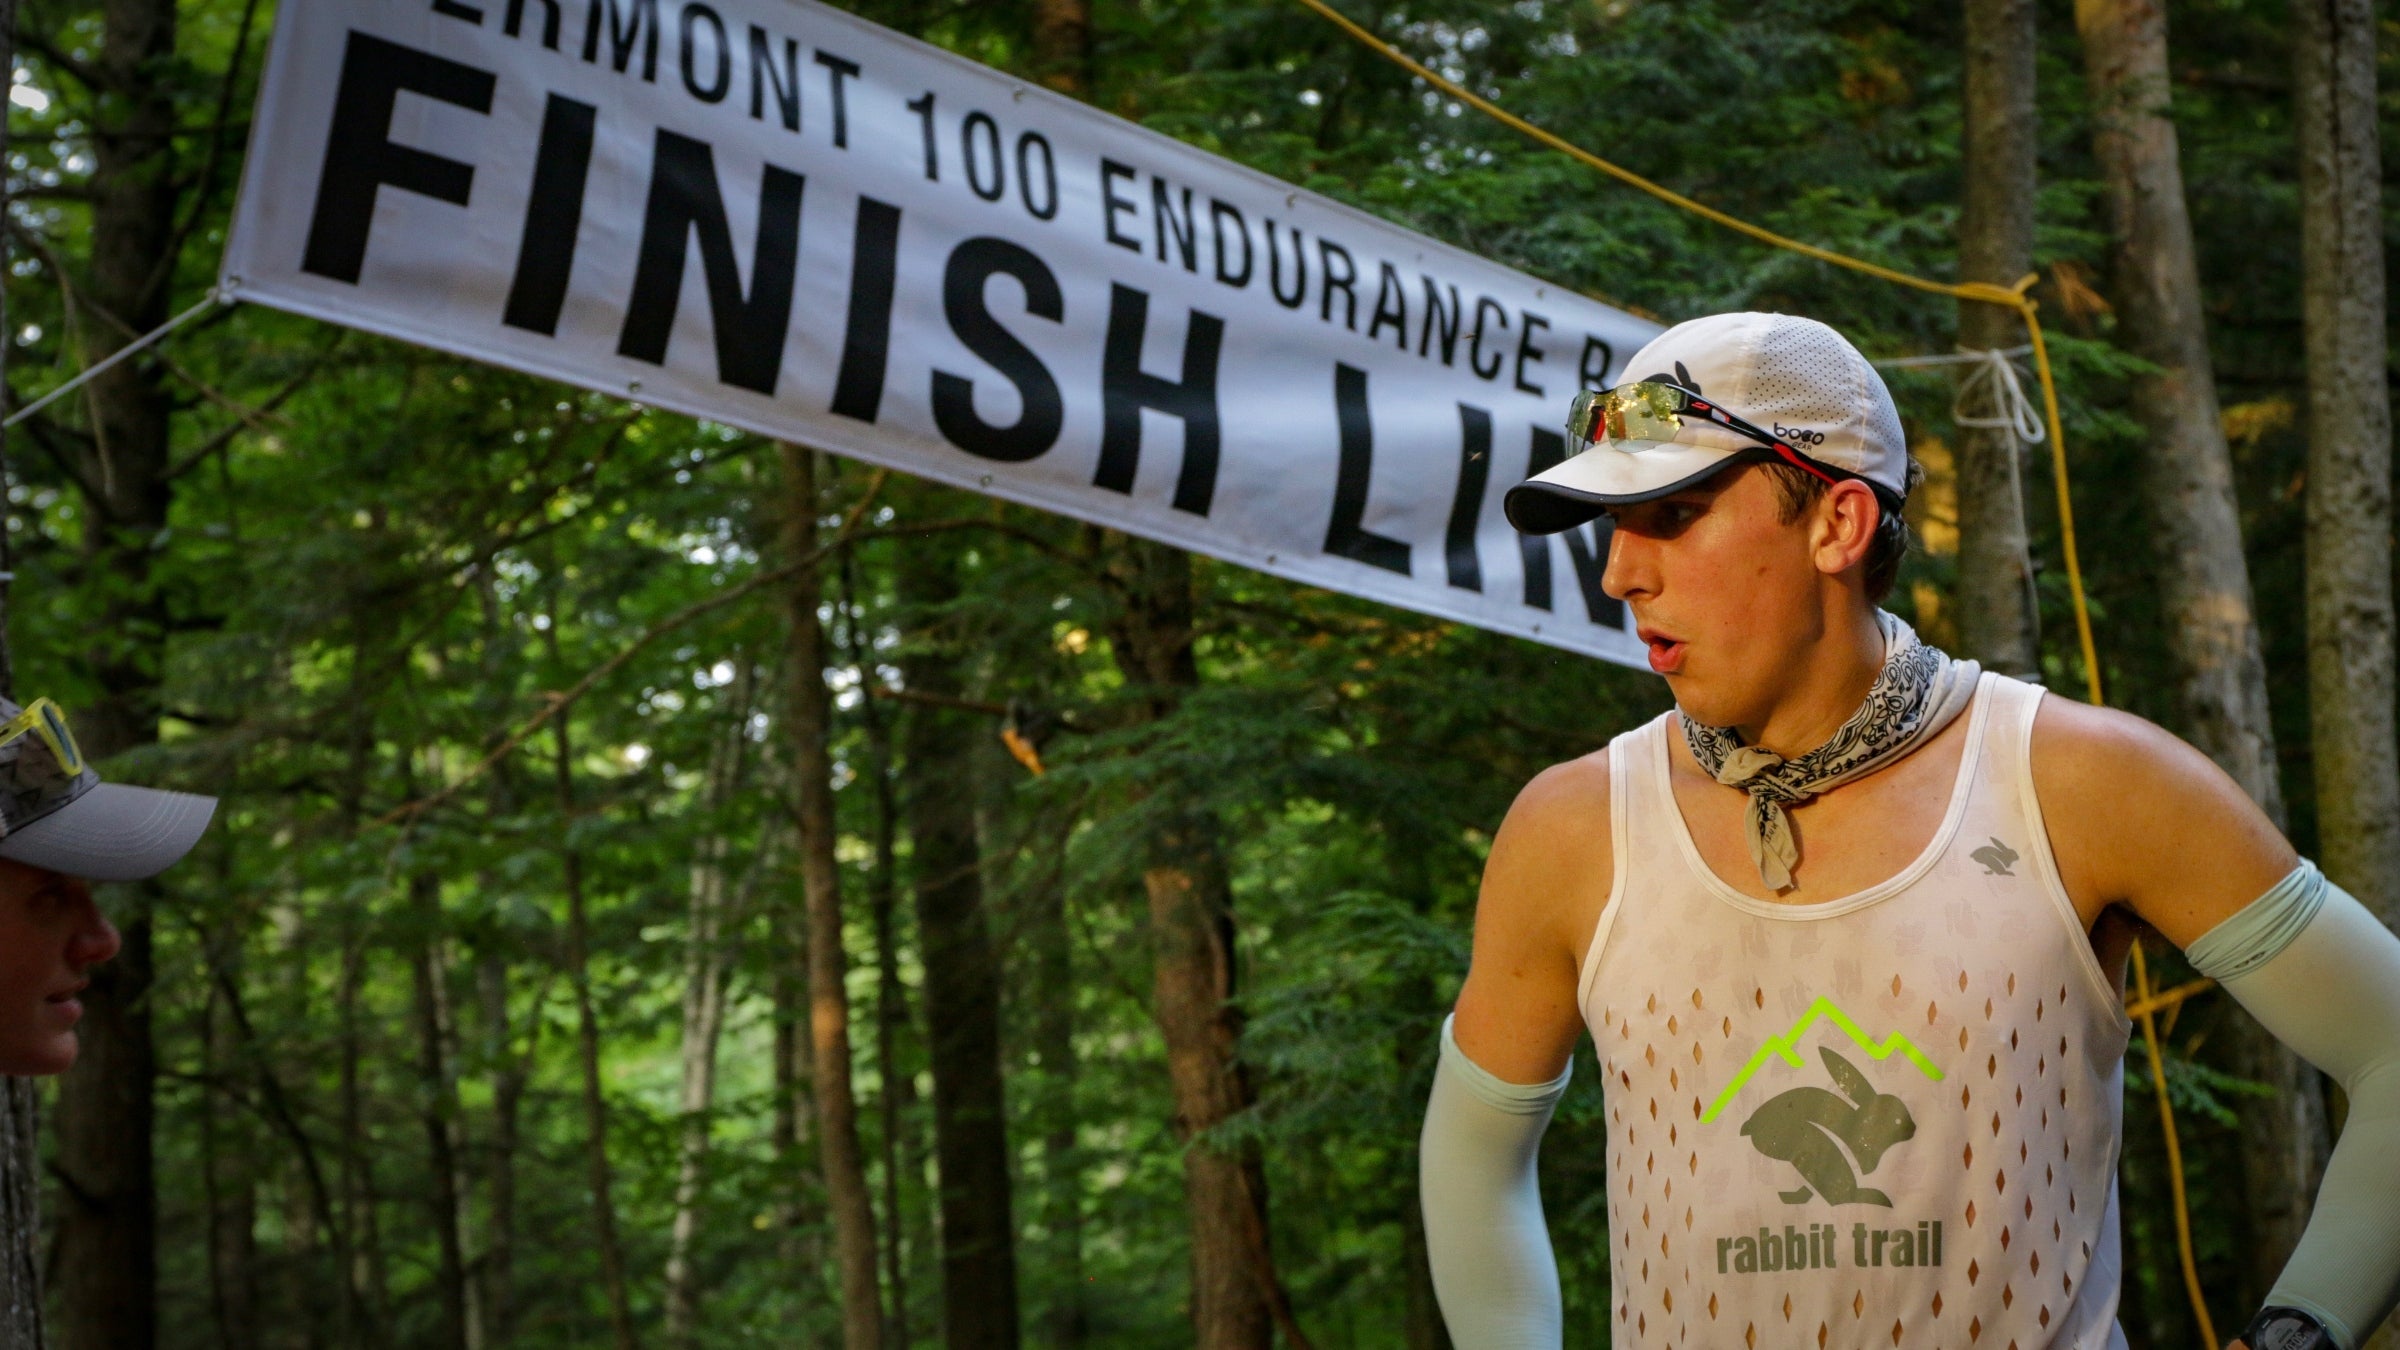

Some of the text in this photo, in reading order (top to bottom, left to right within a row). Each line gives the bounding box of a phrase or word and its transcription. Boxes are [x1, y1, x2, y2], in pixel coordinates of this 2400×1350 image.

[432, 0, 1551, 397] MONT 100 ENDURANCE
[301, 29, 1627, 632] FINISH LIN
[1774, 422, 1825, 446] boco
[1717, 1221, 1943, 1274] rabbit trail
